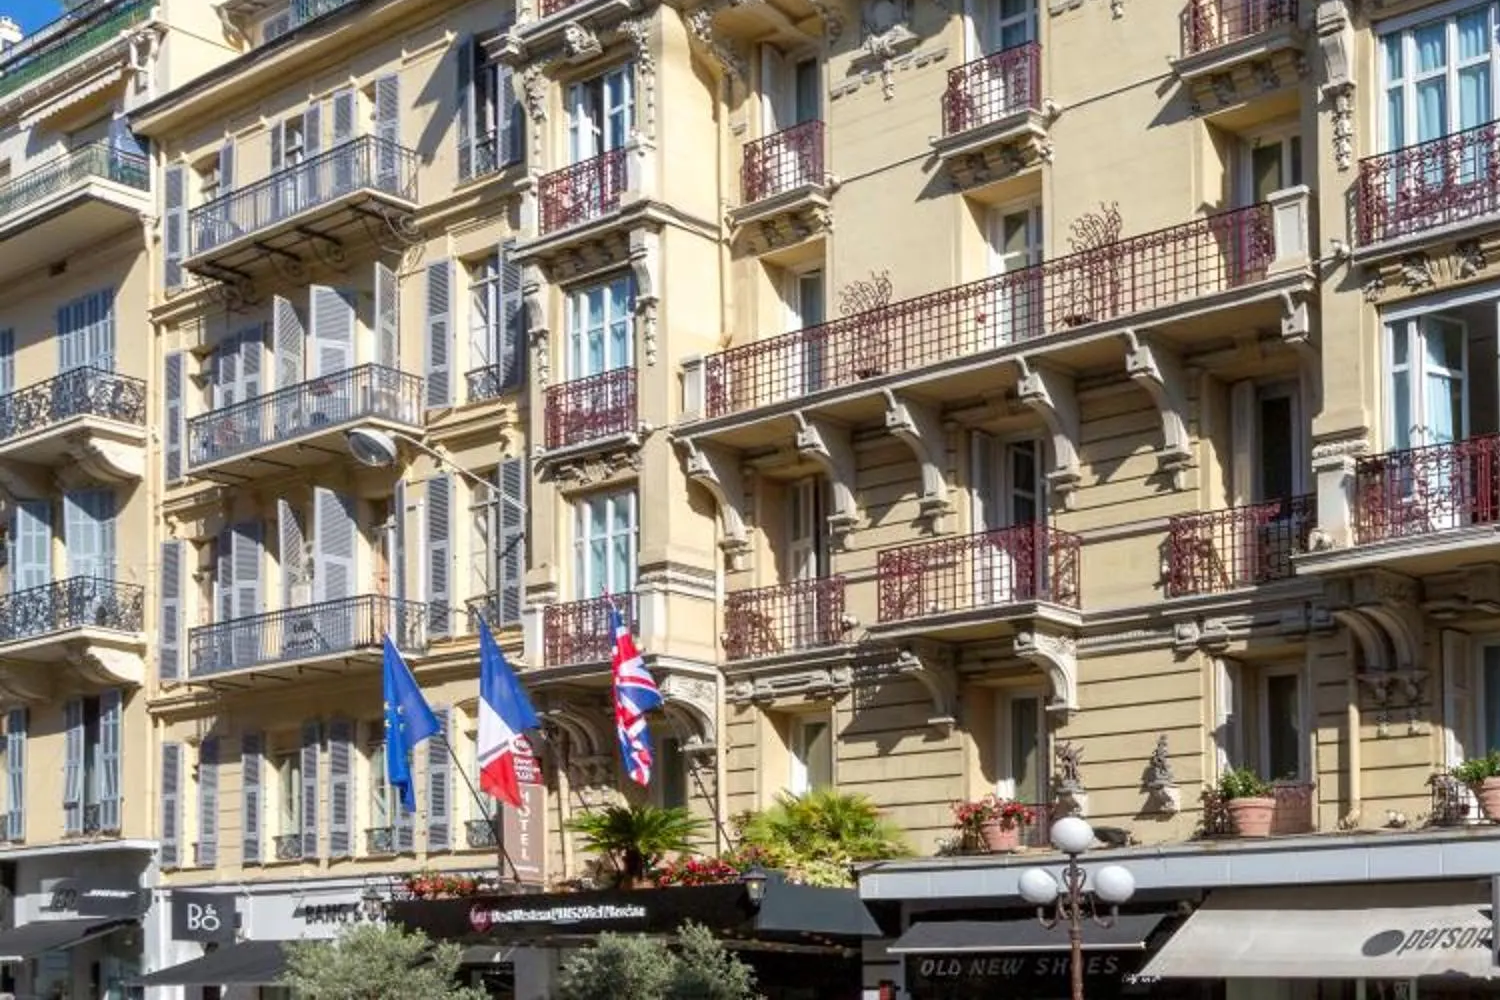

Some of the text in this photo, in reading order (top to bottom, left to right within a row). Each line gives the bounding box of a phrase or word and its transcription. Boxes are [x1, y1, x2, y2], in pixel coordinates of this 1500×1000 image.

[919, 956, 1120, 976] OLD NEW SHES
